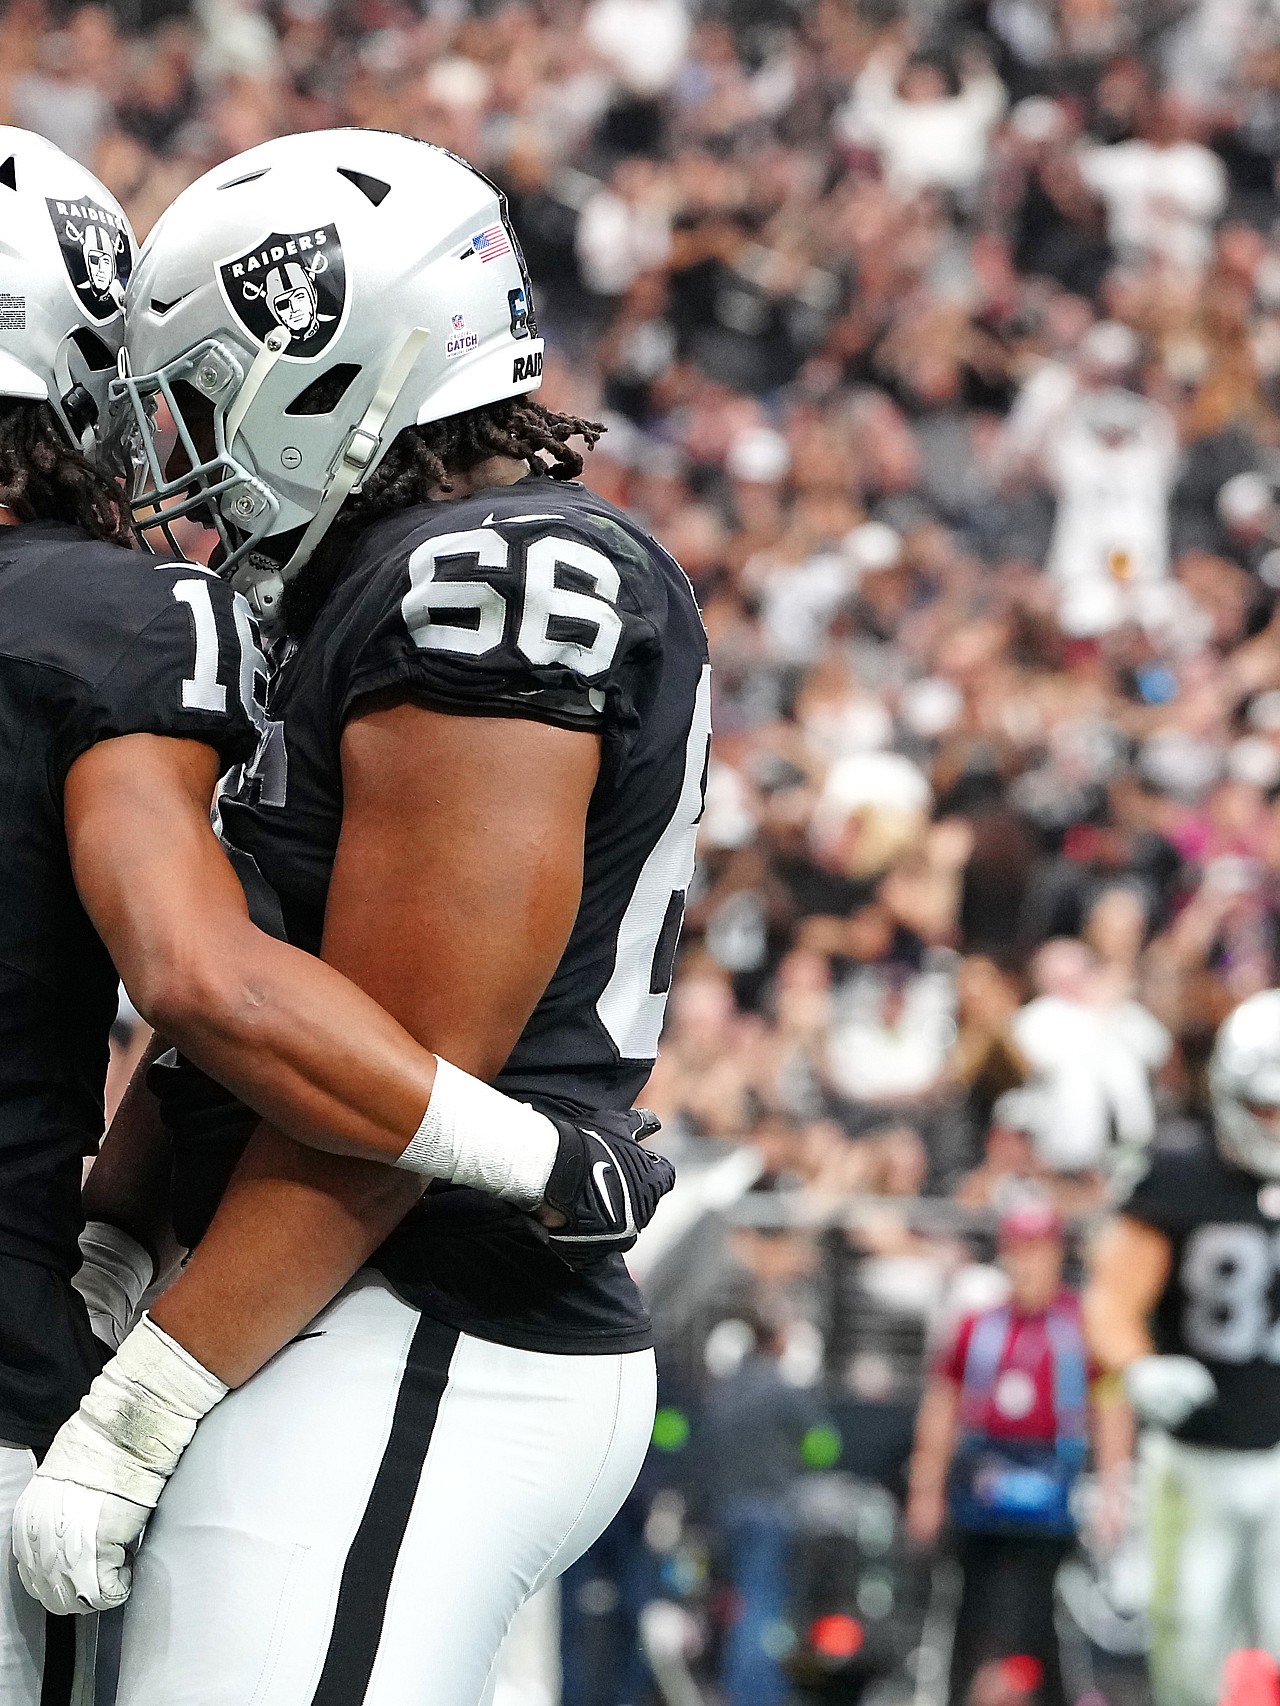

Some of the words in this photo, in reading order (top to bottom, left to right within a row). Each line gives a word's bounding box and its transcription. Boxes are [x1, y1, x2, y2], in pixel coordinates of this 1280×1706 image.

[232, 230, 327, 278] RAIDERS
[447, 333, 477, 352] CATCH
[402, 528, 623, 677] 66
